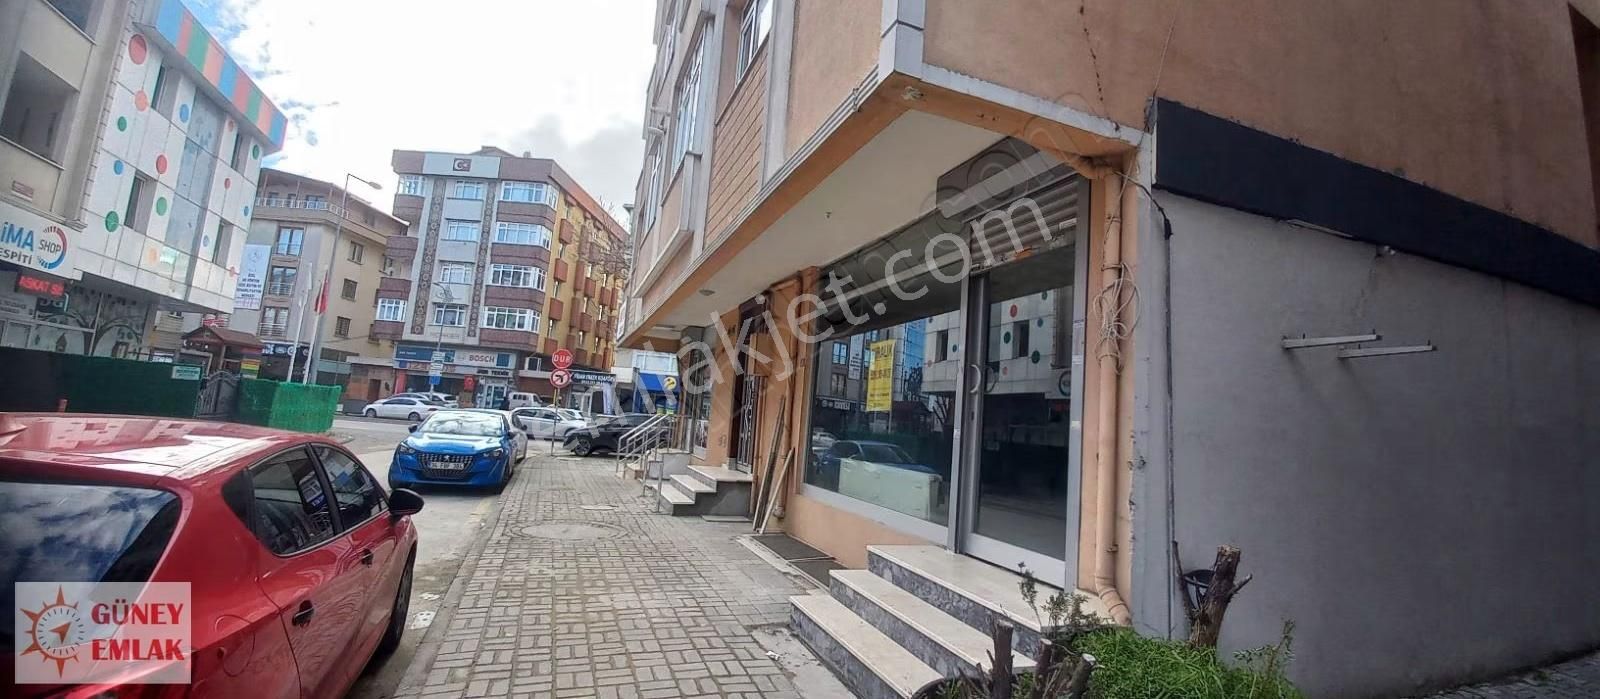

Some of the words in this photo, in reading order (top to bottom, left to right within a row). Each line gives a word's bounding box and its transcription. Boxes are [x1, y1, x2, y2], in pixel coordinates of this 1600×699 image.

[39, 238, 62, 257] SHOP
[469, 354, 495, 363] BOSCH
[553, 354, 570, 363] DUR
